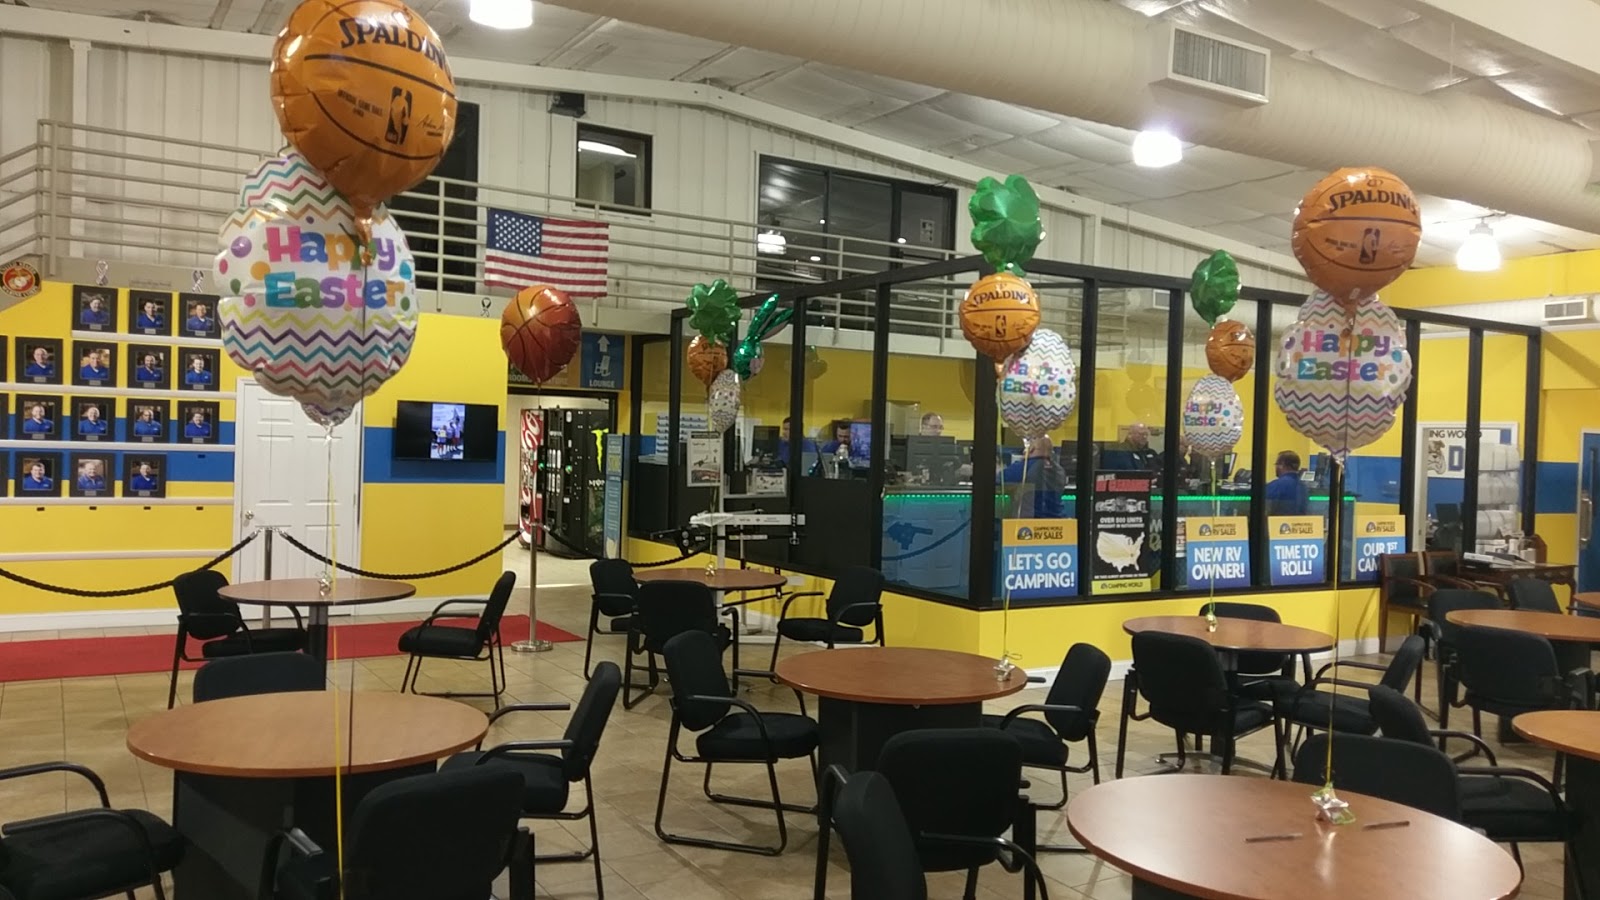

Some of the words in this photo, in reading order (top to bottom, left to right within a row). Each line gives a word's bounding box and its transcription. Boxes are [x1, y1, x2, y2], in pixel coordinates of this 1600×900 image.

[338, 18, 453, 81] SPALDIN
[1328, 189, 1418, 216] SPALDING
[265, 226, 395, 271] Happy
[264, 271, 406, 309] Easter
[973, 290, 1031, 305] SPALDING
[1302, 330, 1390, 357] Happy
[1007, 360, 1059, 381] Happy
[1297, 358, 1393, 381] Easter
[589, 379, 615, 388] LOUNGE
[1003, 378, 1059, 396] Easter
[1186, 400, 1222, 414] Happy
[1185, 415, 1224, 426] Easter
[1034, 531, 1042, 540] RV
[1043, 531, 1063, 540] SALES
[1194, 547, 1224, 563] NEW
[1225, 546, 1242, 562] RV
[1274, 545, 1301, 560] TIME
[1302, 544, 1319, 559] TO
[1363, 542, 1385, 557] OUR
[1008, 552, 1044, 571] LET'S
[1046, 552, 1072, 569] GO
[1281, 560, 1312, 576] ROLL!
[1358, 558, 1378, 572] CAM
[1192, 563, 1246, 580] OWNER!
[1005, 572, 1075, 590] CAMPING!
